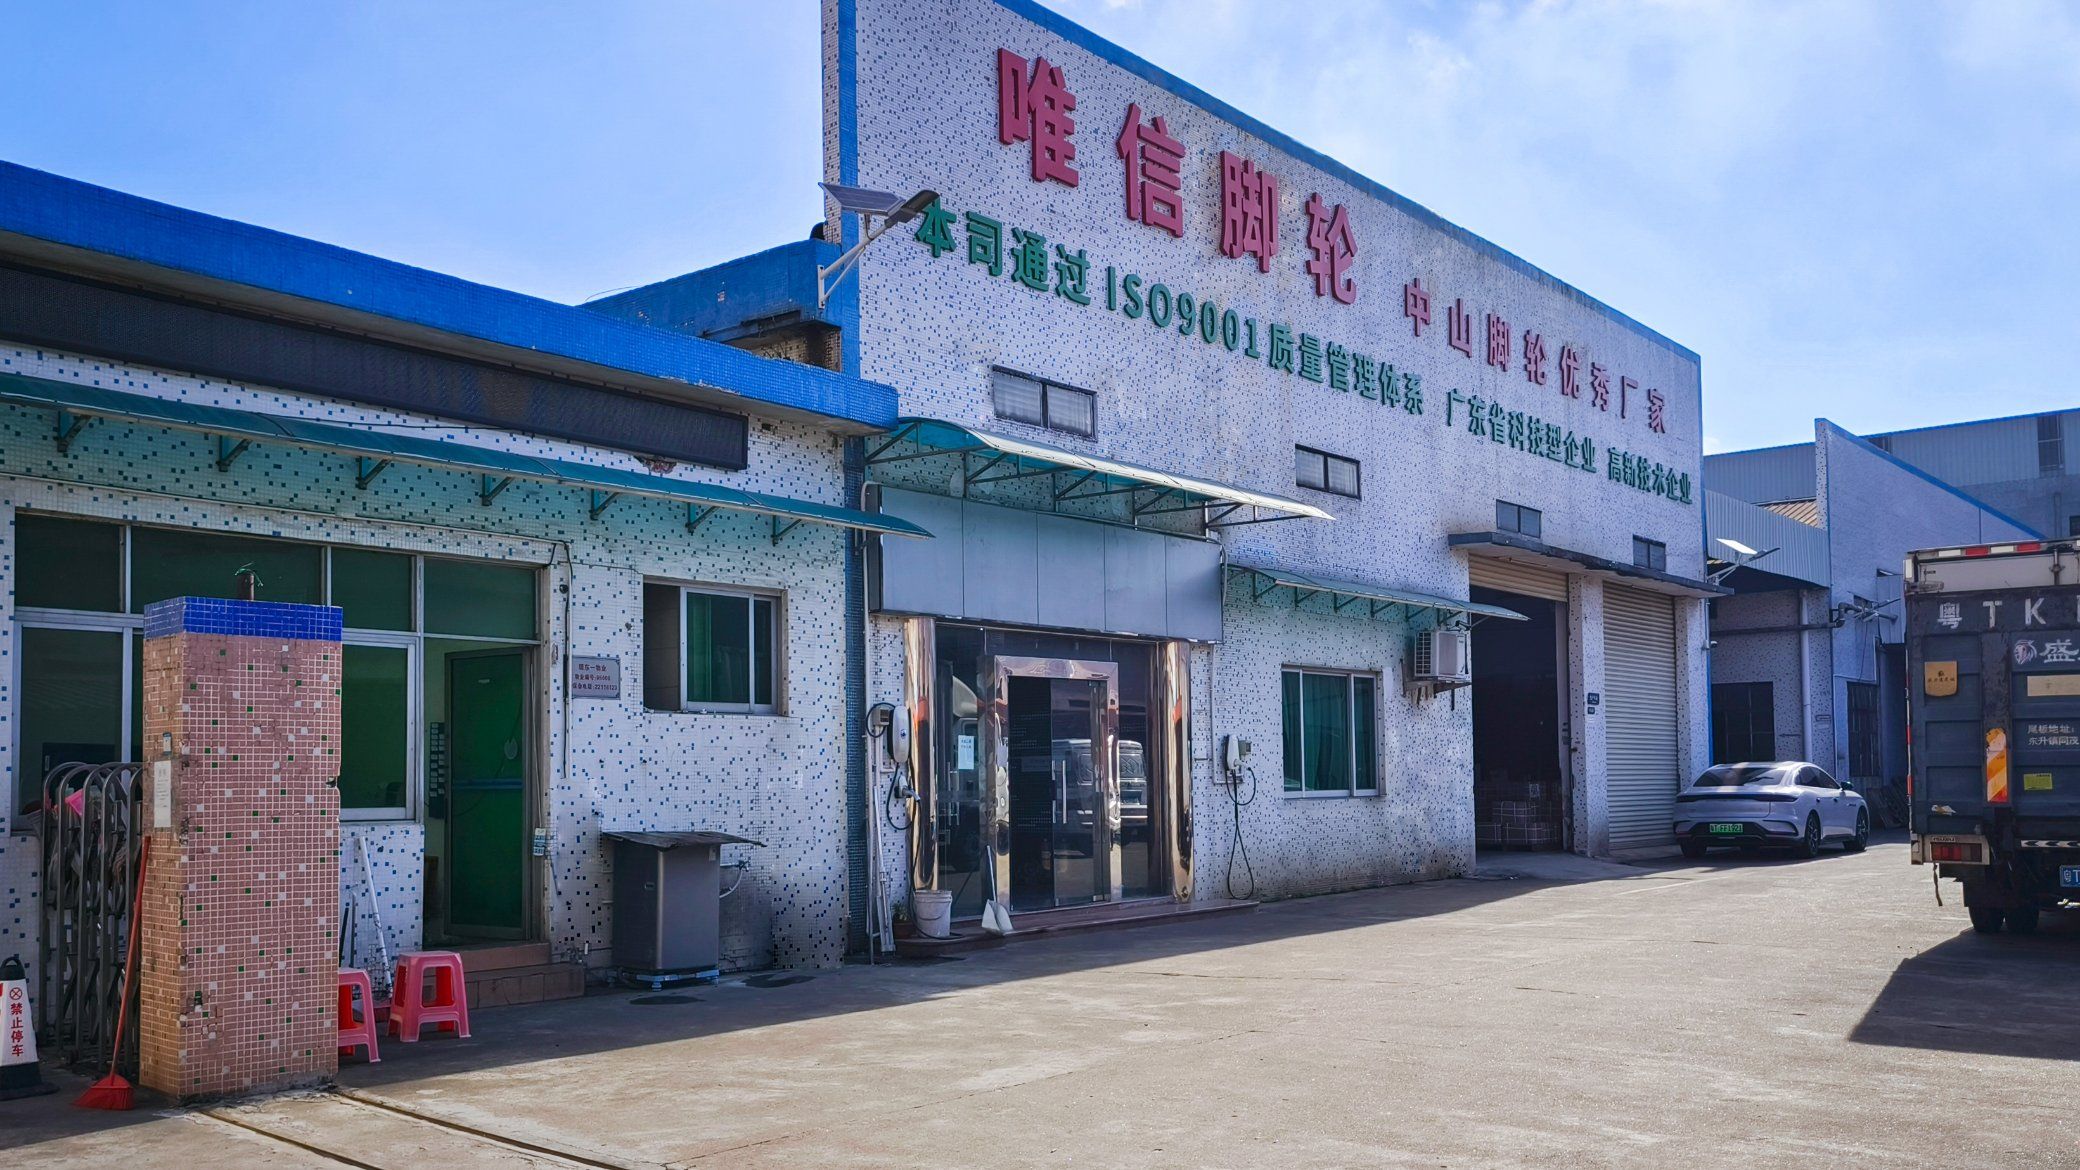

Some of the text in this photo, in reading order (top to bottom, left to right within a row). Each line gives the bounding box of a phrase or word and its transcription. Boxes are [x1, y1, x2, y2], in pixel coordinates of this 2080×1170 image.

[998, 47, 1358, 304] 唯信脚轮
[1404, 277, 1666, 433] 中山脚轮优秀厂家
[1447, 388, 1692, 504] 广东省科技型企业 高新技术企业
[1937, 594, 2080, 629] 粤TK
[2040, 639, 2080, 663] 盛
[11, 1003, 24, 1056] 禁止停车
